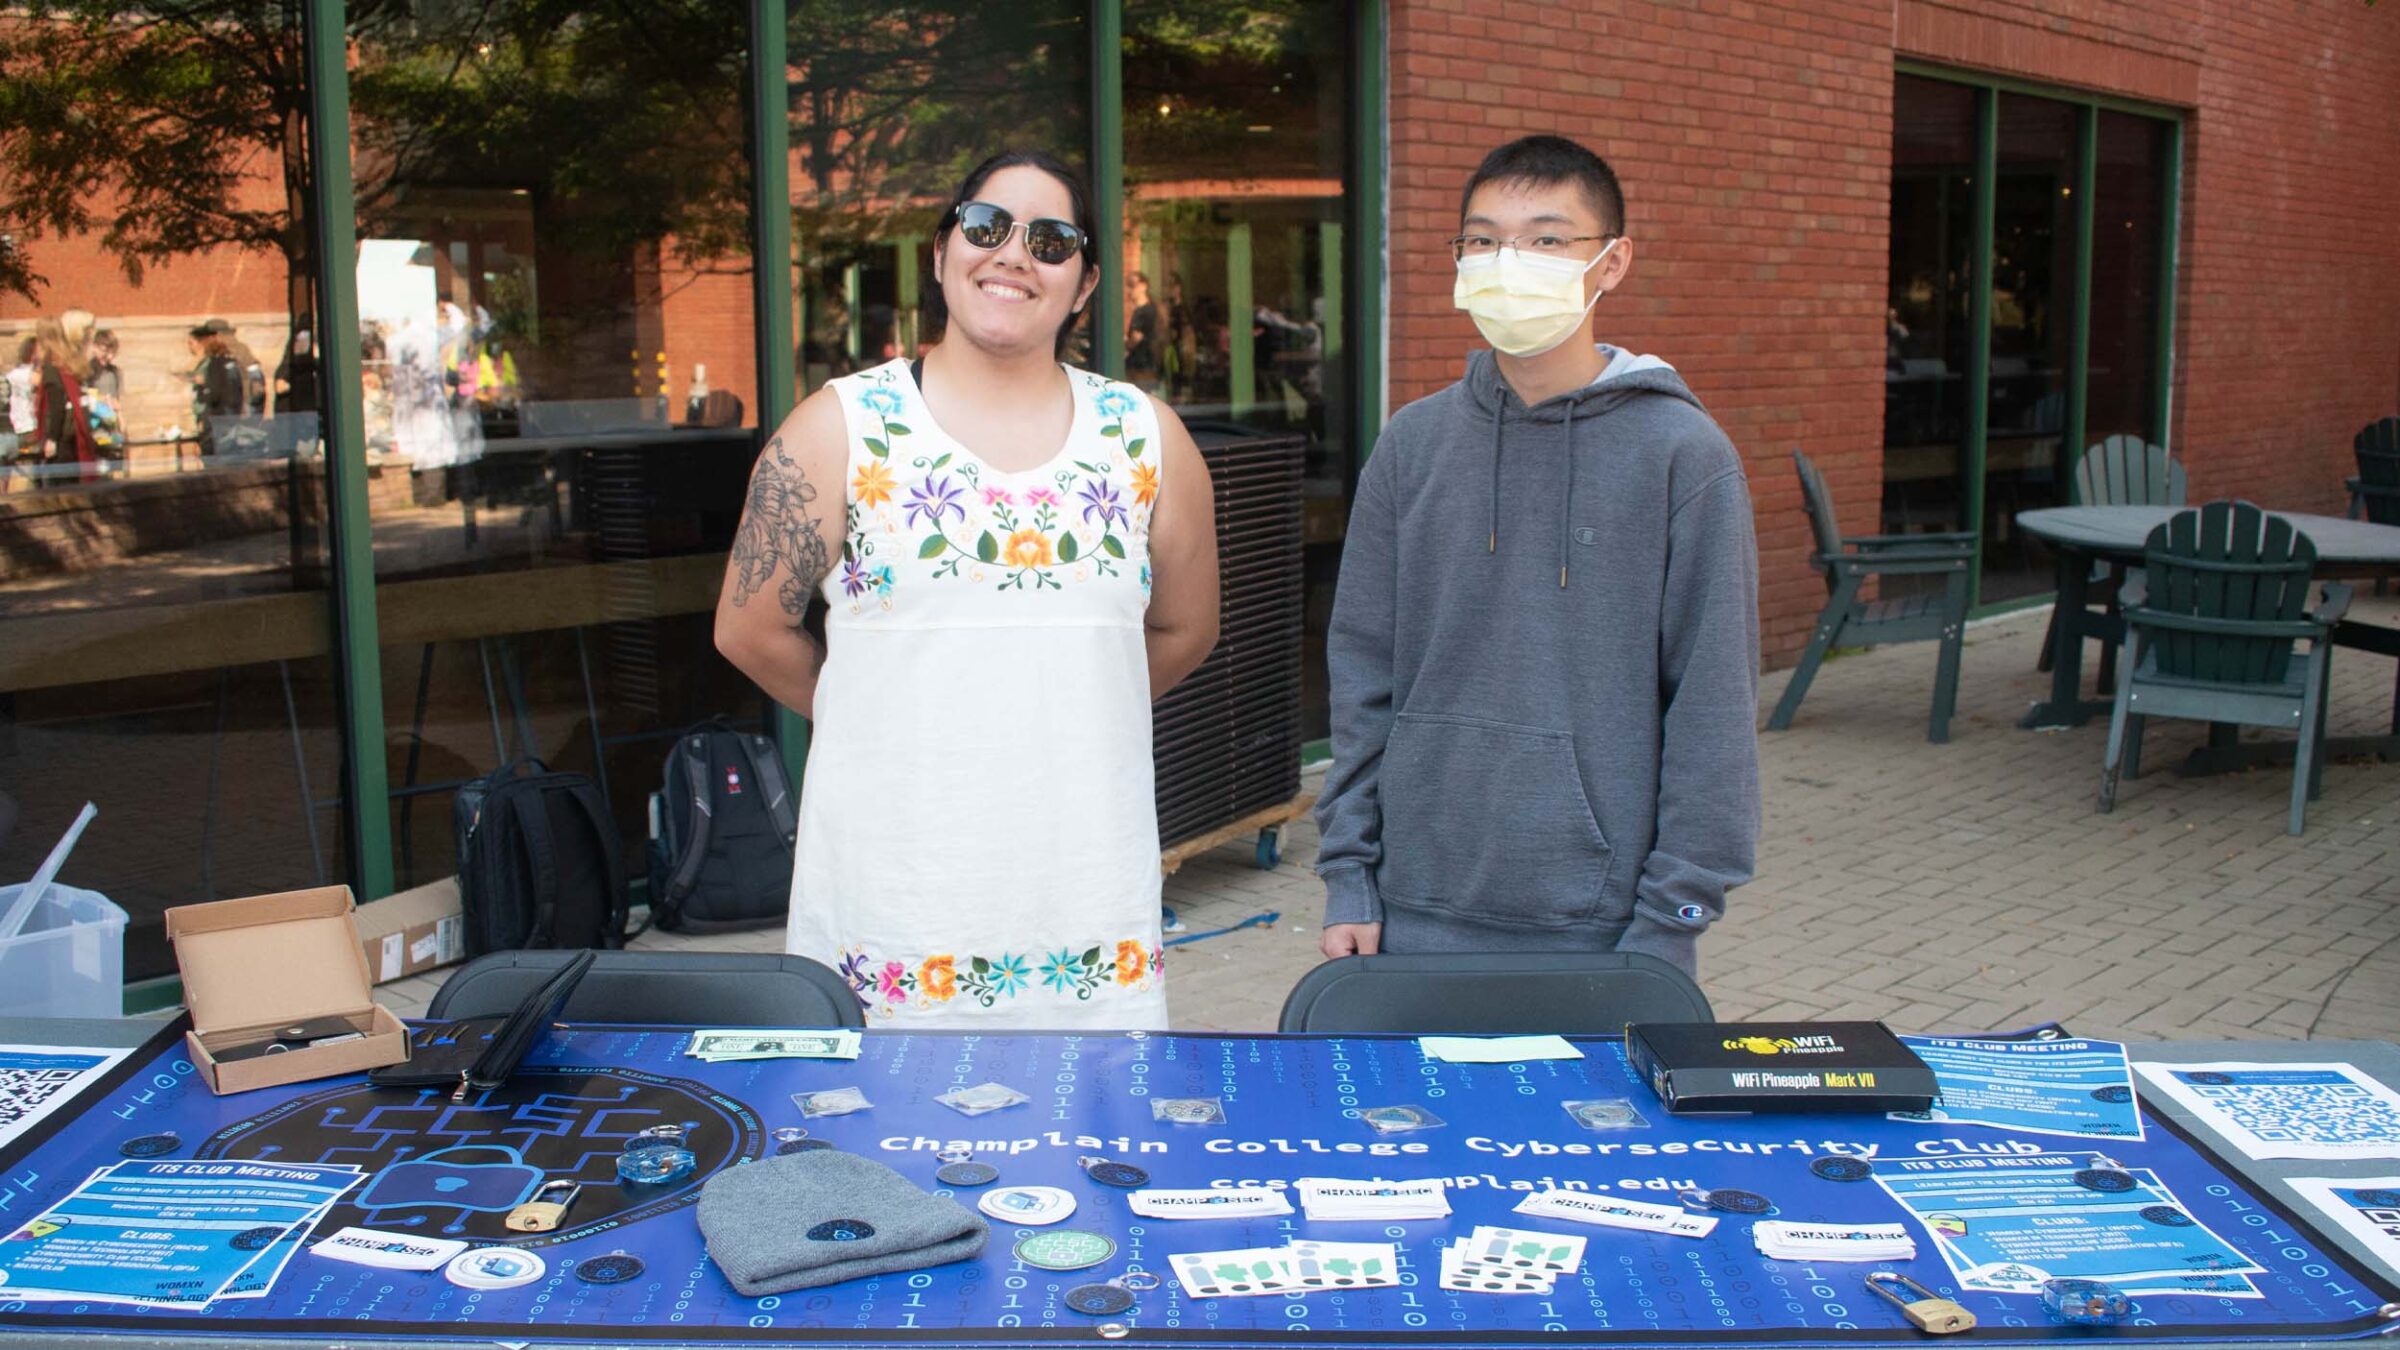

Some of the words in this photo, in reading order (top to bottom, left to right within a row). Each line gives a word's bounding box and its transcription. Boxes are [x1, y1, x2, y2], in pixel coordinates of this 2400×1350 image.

[1794, 1035, 1835, 1047] WiFi
[1963, 1042, 2007, 1051] CLUB
[2012, 1042, 2088, 1052] MEETING
[1732, 1072, 1760, 1088] WiFi
[1762, 1072, 1820, 1089] Pineapple
[1825, 1072, 1856, 1088] Mark
[1858, 1072, 1875, 1088] VII
[880, 1132, 1168, 1155] Champlain
[1205, 1138, 1429, 1156] College
[1465, 1137, 1879, 1158] Cybersecurity
[1915, 1138, 2042, 1155] Club
[1900, 1161, 1935, 1171] ITS
[1936, 1159, 1987, 1169] CLUB
[1986, 1157, 2074, 1168] MEETING
[148, 1164, 184, 1174] ITS
[183, 1164, 235, 1176] CLUB
[235, 1166, 321, 1181] MEETING
[2031, 1216, 2090, 1226] CLUBS:
[119, 1230, 176, 1241] CLUBS:
[156, 1280, 204, 1290] WOMXN
